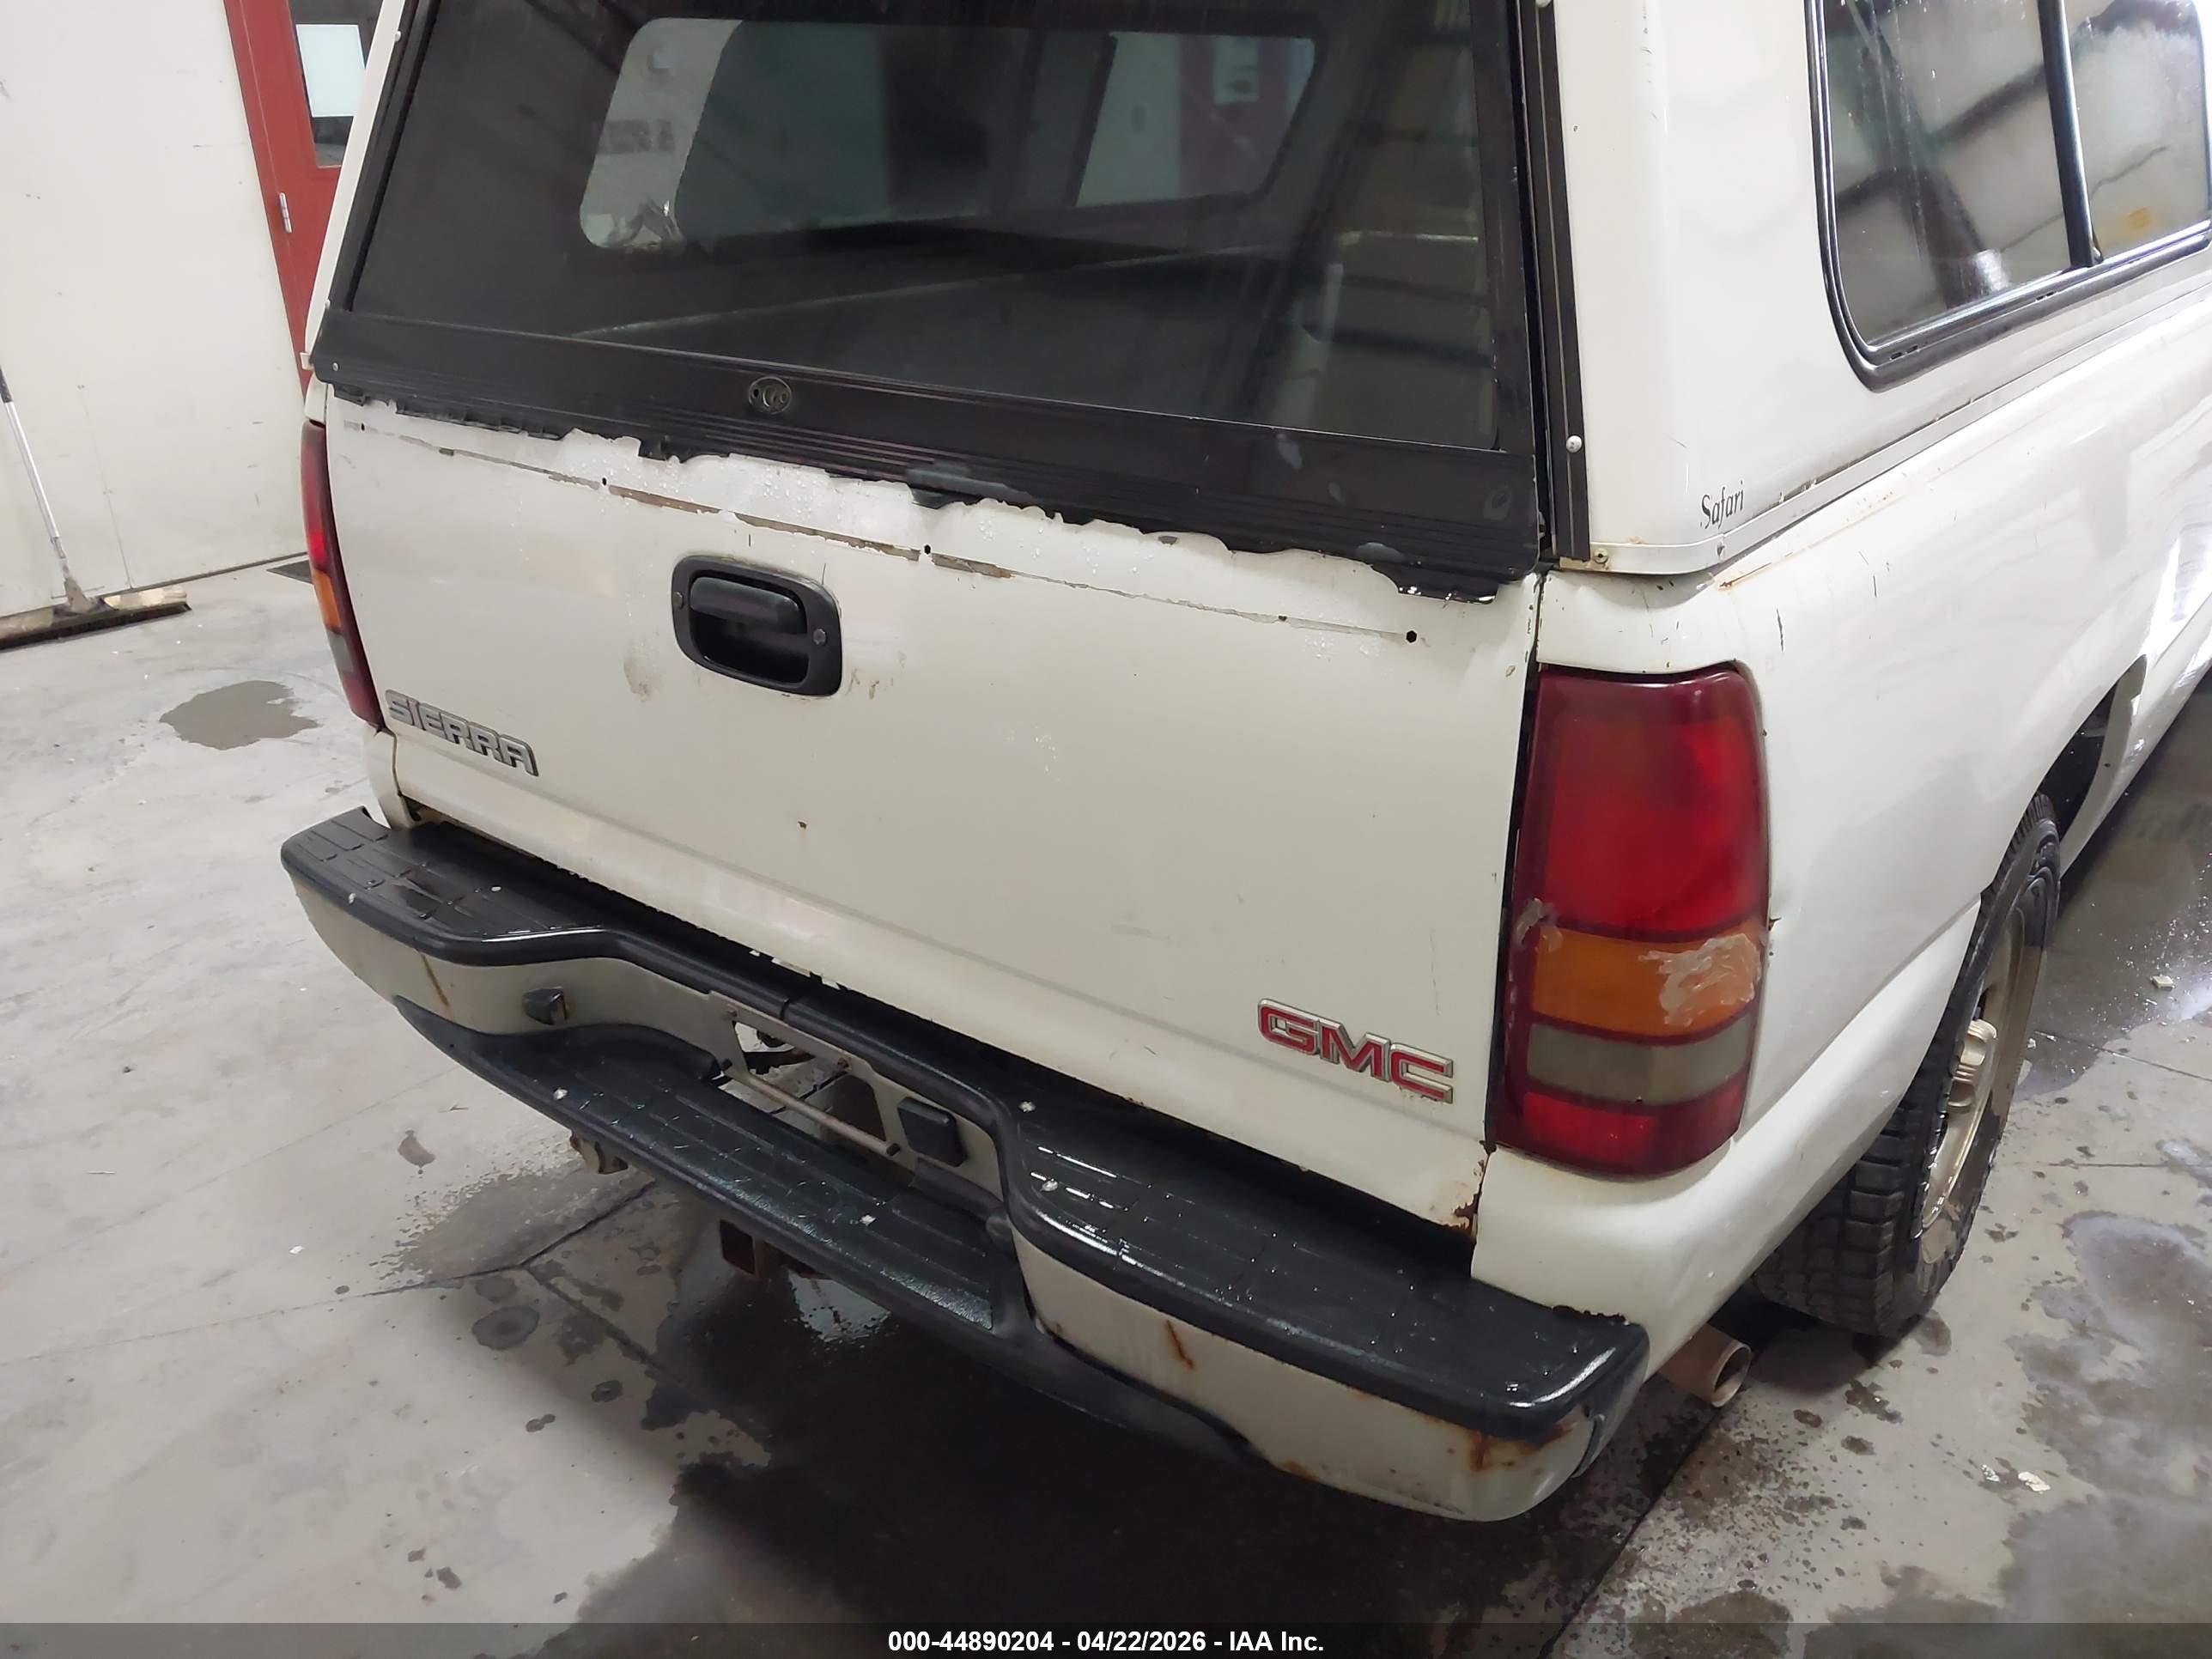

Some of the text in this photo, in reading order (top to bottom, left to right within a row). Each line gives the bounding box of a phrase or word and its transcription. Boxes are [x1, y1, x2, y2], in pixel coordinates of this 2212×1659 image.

[1700, 480, 1744, 529] Safari
[386, 690, 539, 776] SIERRA
[1258, 998, 1454, 1104] GMC
